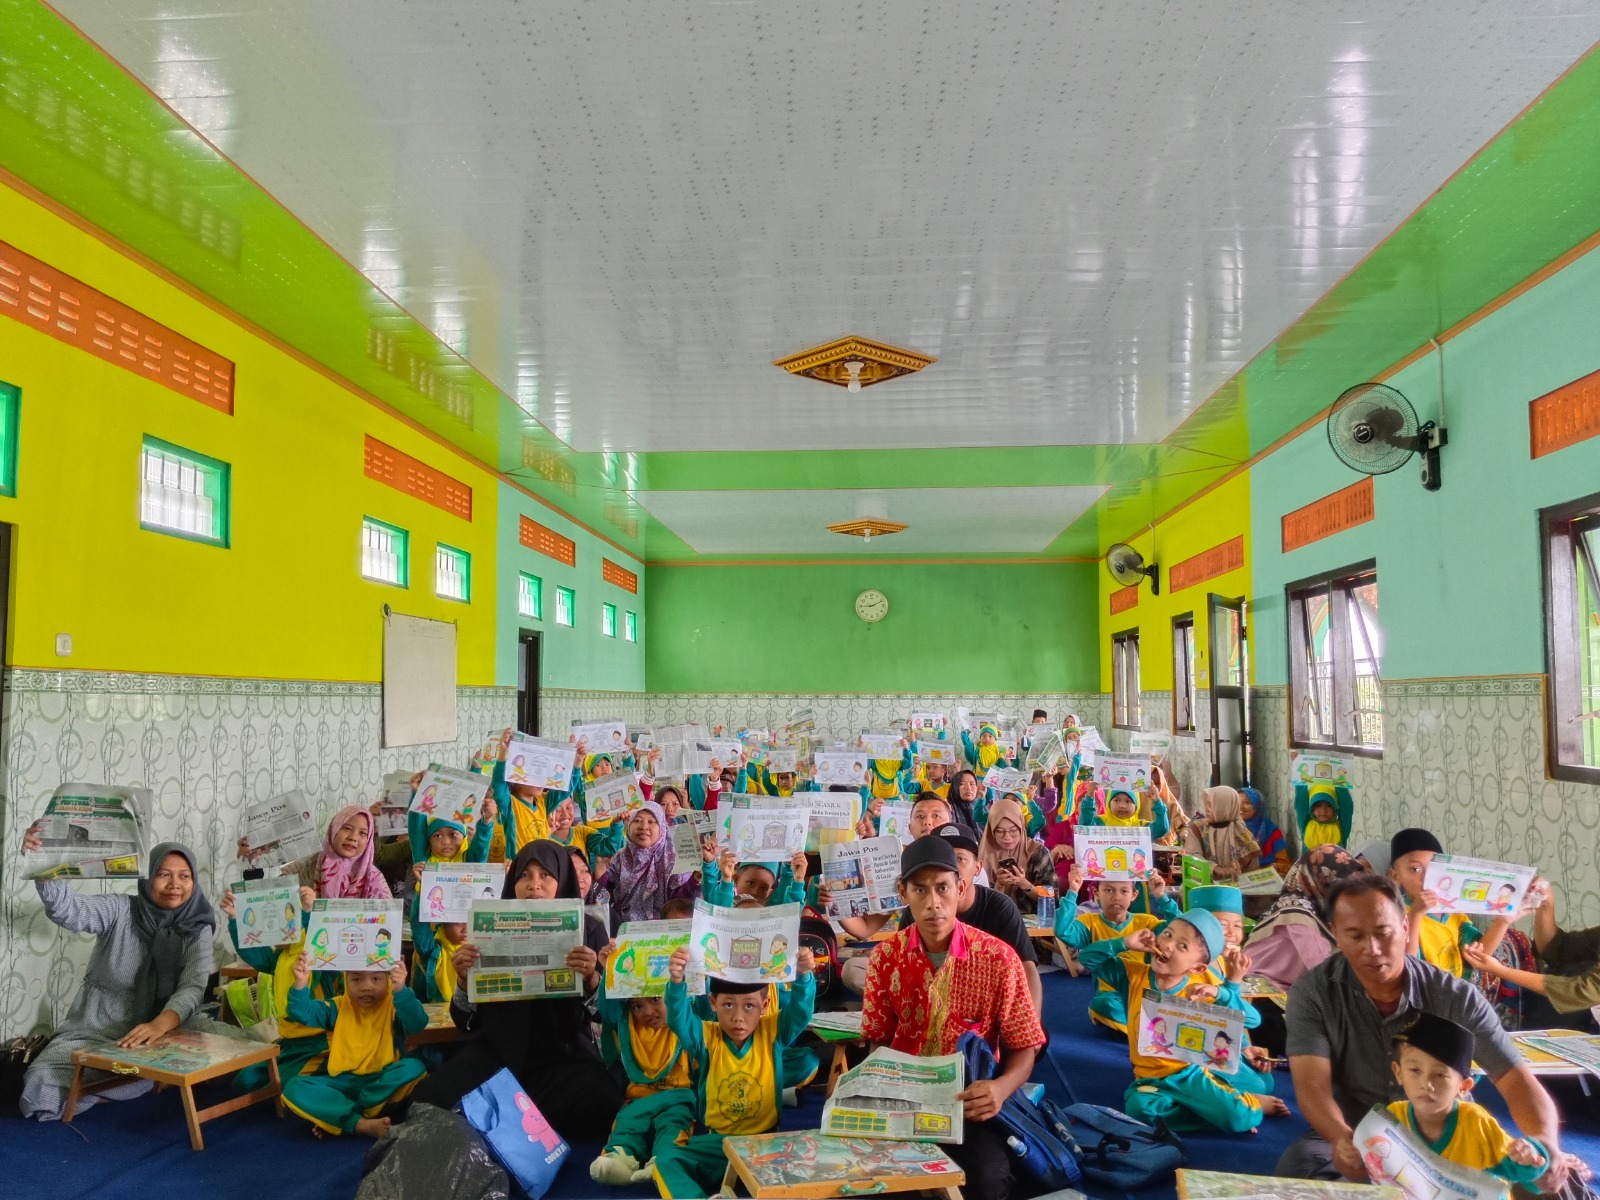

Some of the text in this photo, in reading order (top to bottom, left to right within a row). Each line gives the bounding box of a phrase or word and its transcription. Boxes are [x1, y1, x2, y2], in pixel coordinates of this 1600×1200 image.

[270, 803, 286, 813] Pos
[837, 846, 879, 858] Jawa Pos
